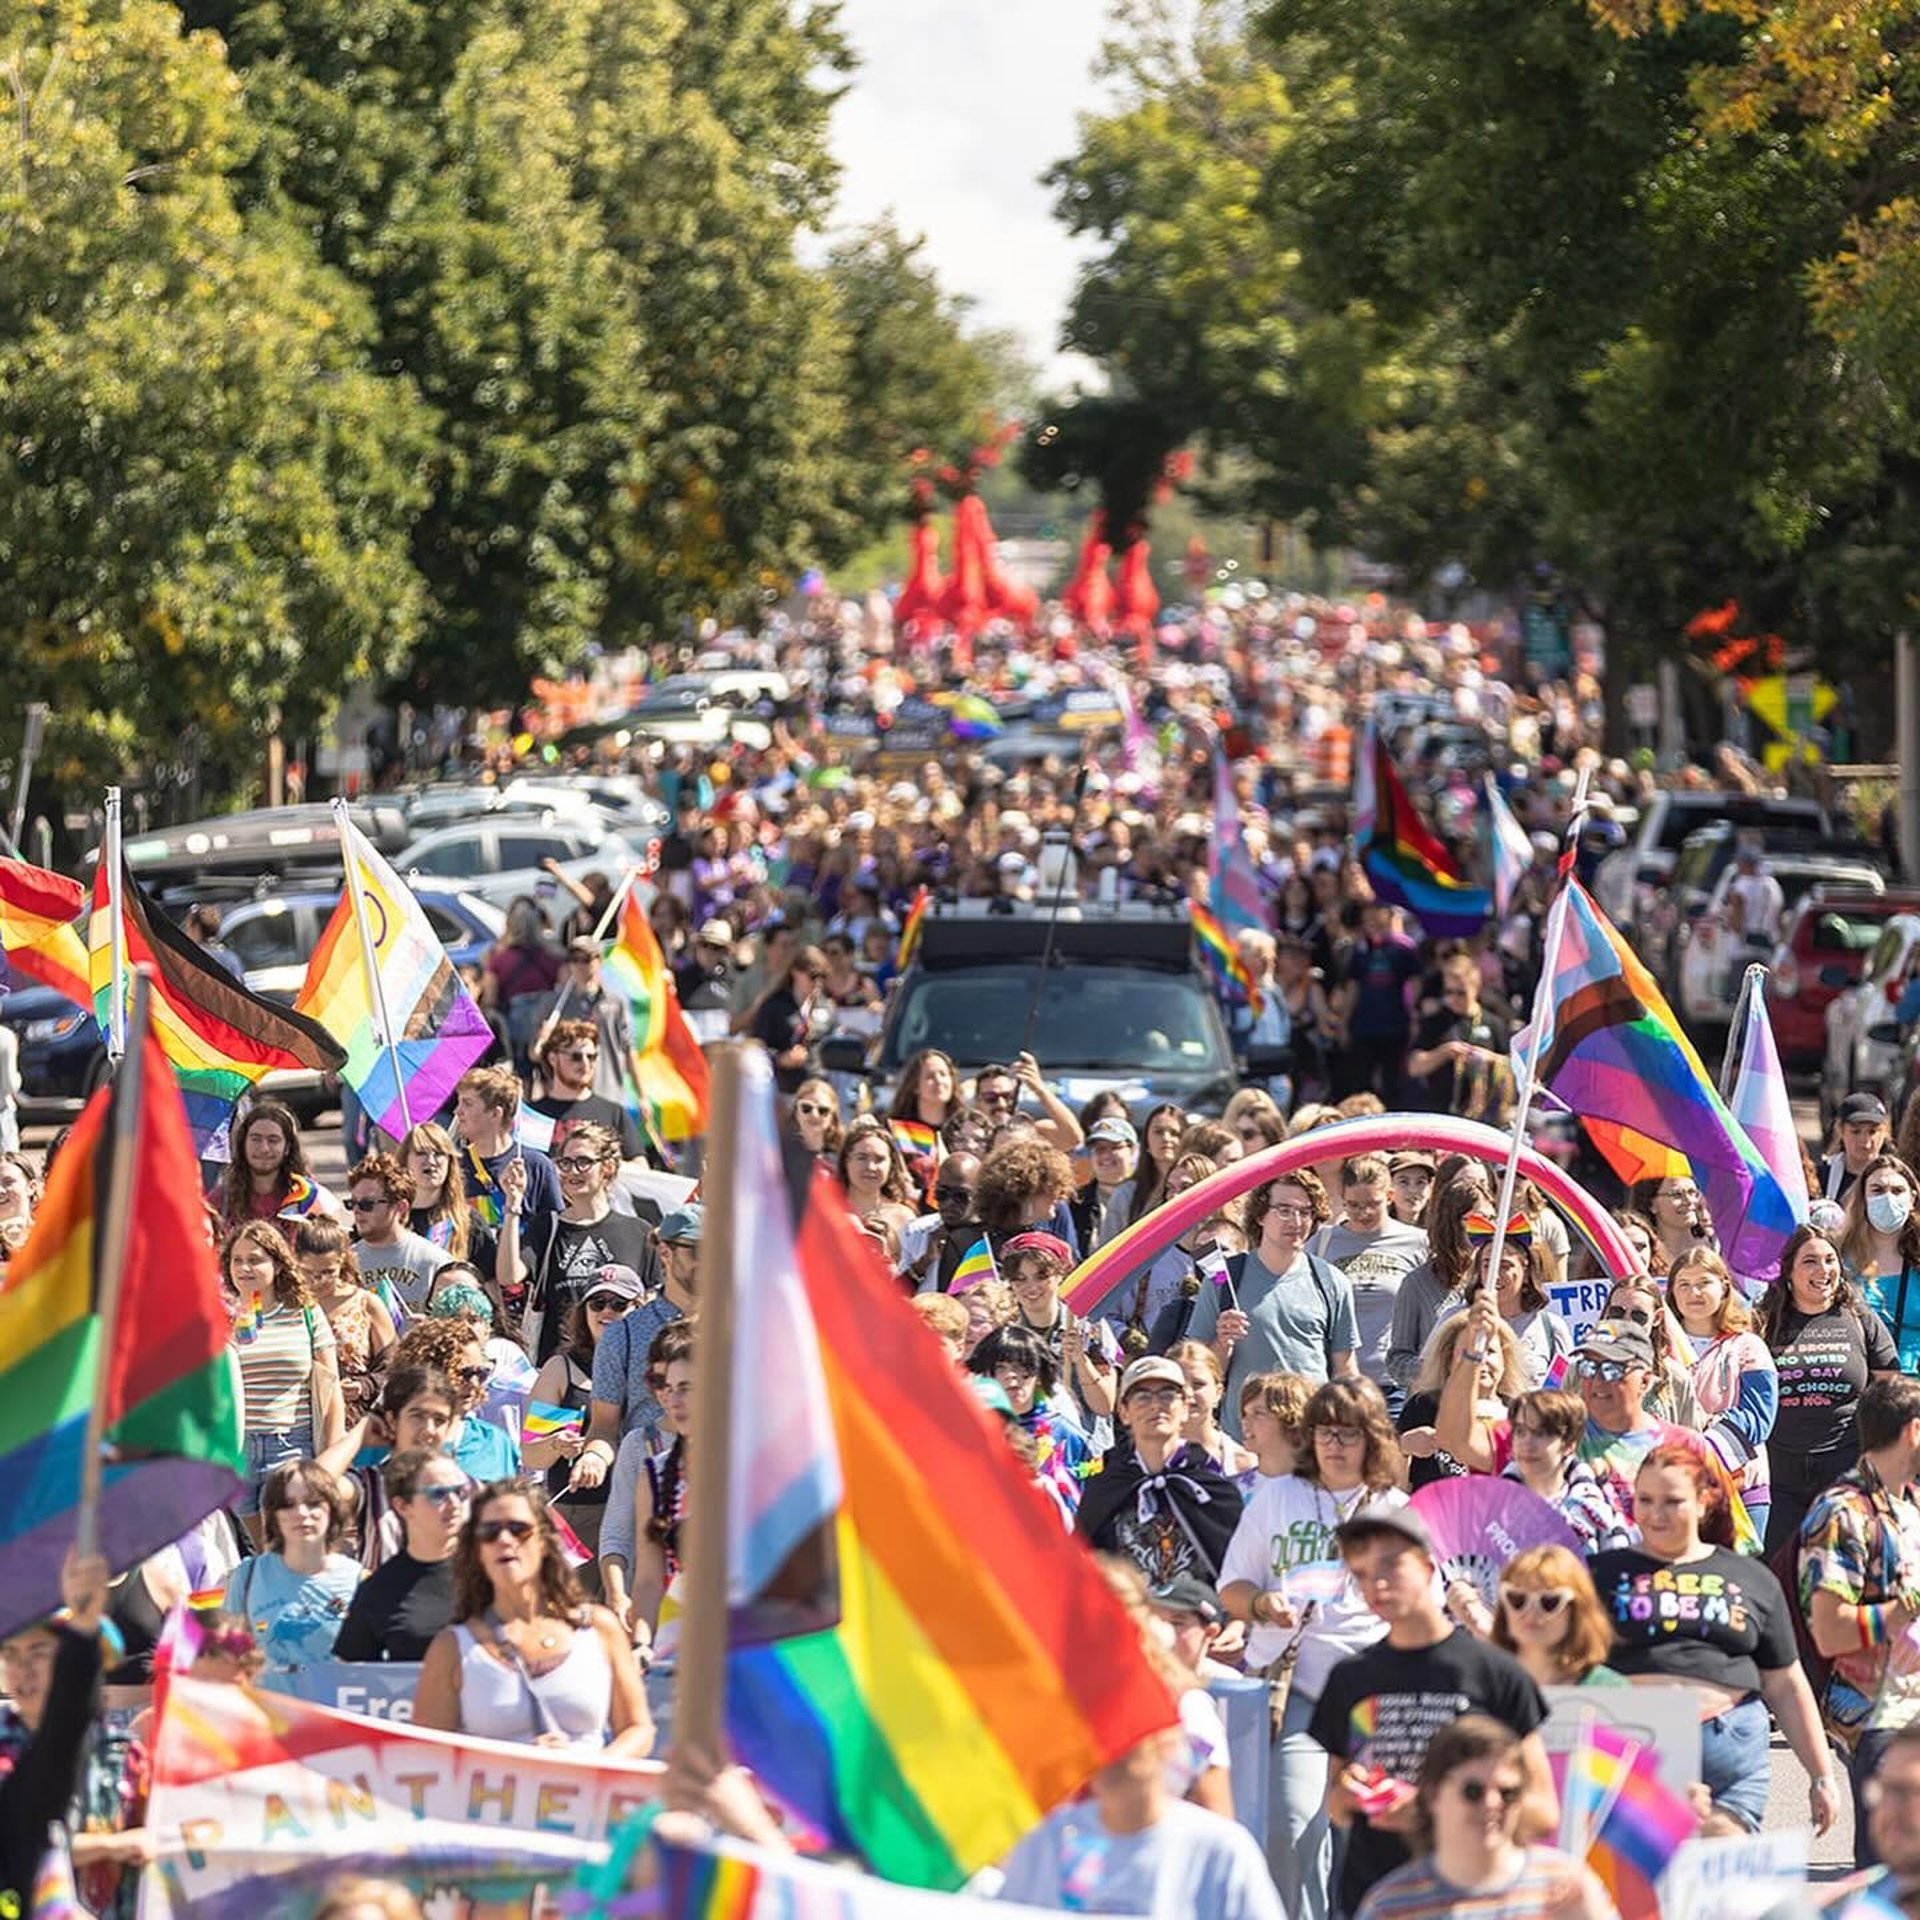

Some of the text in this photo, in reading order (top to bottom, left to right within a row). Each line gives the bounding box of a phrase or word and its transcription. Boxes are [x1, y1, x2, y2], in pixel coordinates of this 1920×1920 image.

[1550, 1283, 1609, 1316] TRA
[1810, 1367, 1842, 1378] GAY
[1796, 1382, 1852, 1394] CHOICE
[1635, 1569, 1725, 1596] FREE
[1614, 1591, 1749, 1632] TO BE ME
[337, 1686, 415, 1721] Fre
